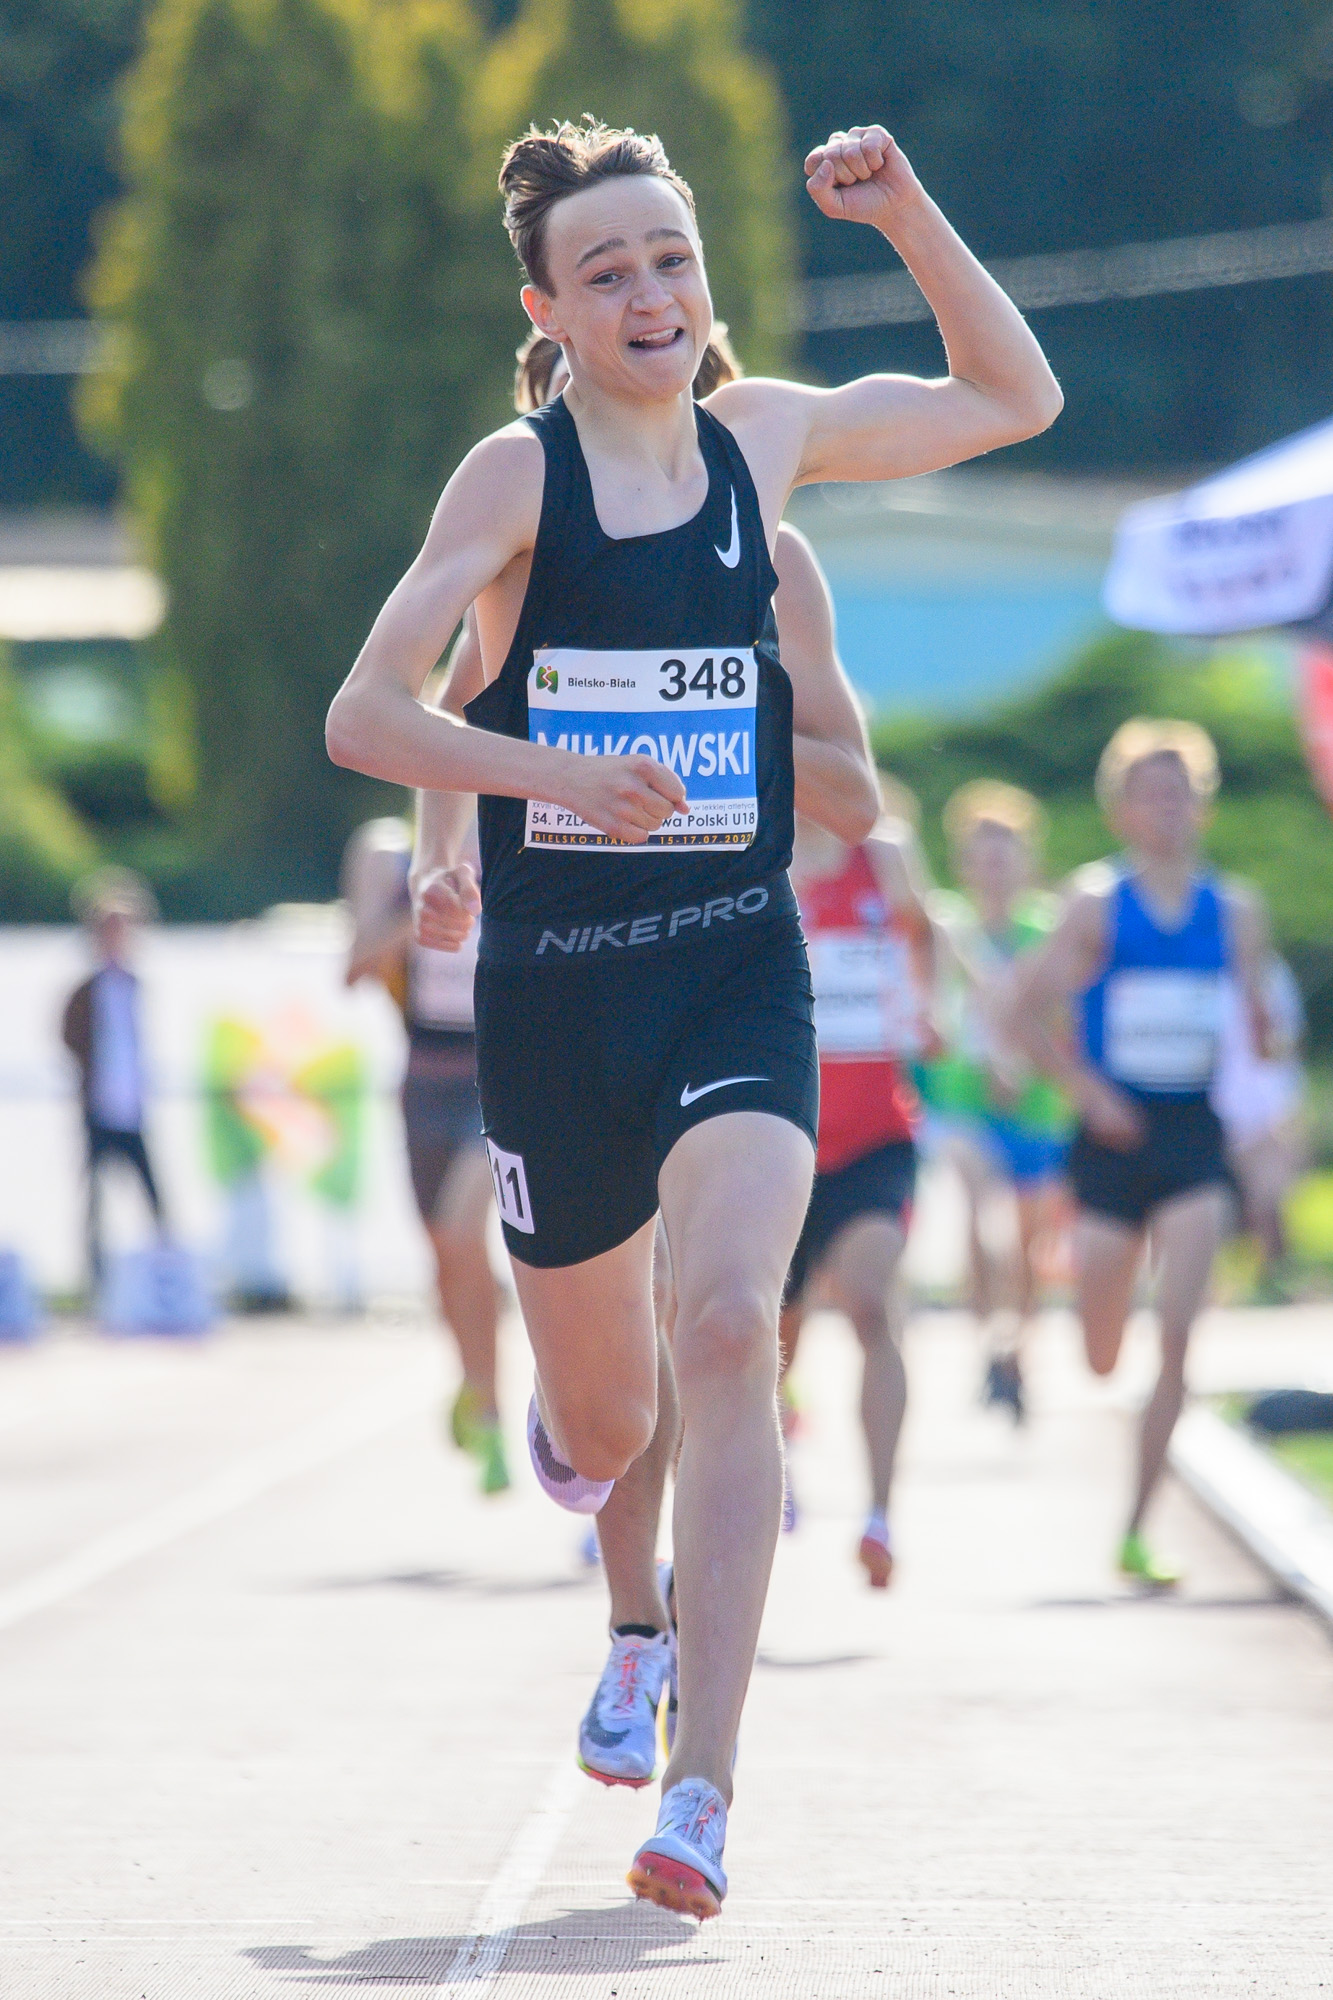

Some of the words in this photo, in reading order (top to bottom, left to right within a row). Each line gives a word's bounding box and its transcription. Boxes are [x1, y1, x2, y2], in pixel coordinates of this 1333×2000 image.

[567, 677, 636, 689] Bielsko-Biała
[658, 656, 746, 702] 348
[702, 803, 726, 812] lekkiej
[727, 802, 755, 811] atletyce
[532, 812, 551, 825] 54.
[687, 813, 728, 828] Polski
[733, 812, 755, 826] U18
[534, 833, 636, 846] BIELSKO-BIAŁ
[660, 834, 752, 845] 15-17.07.2022
[535, 914, 663, 955] NIKE
[668, 887, 769, 938] PRO
[493, 1157, 525, 1220] 11
